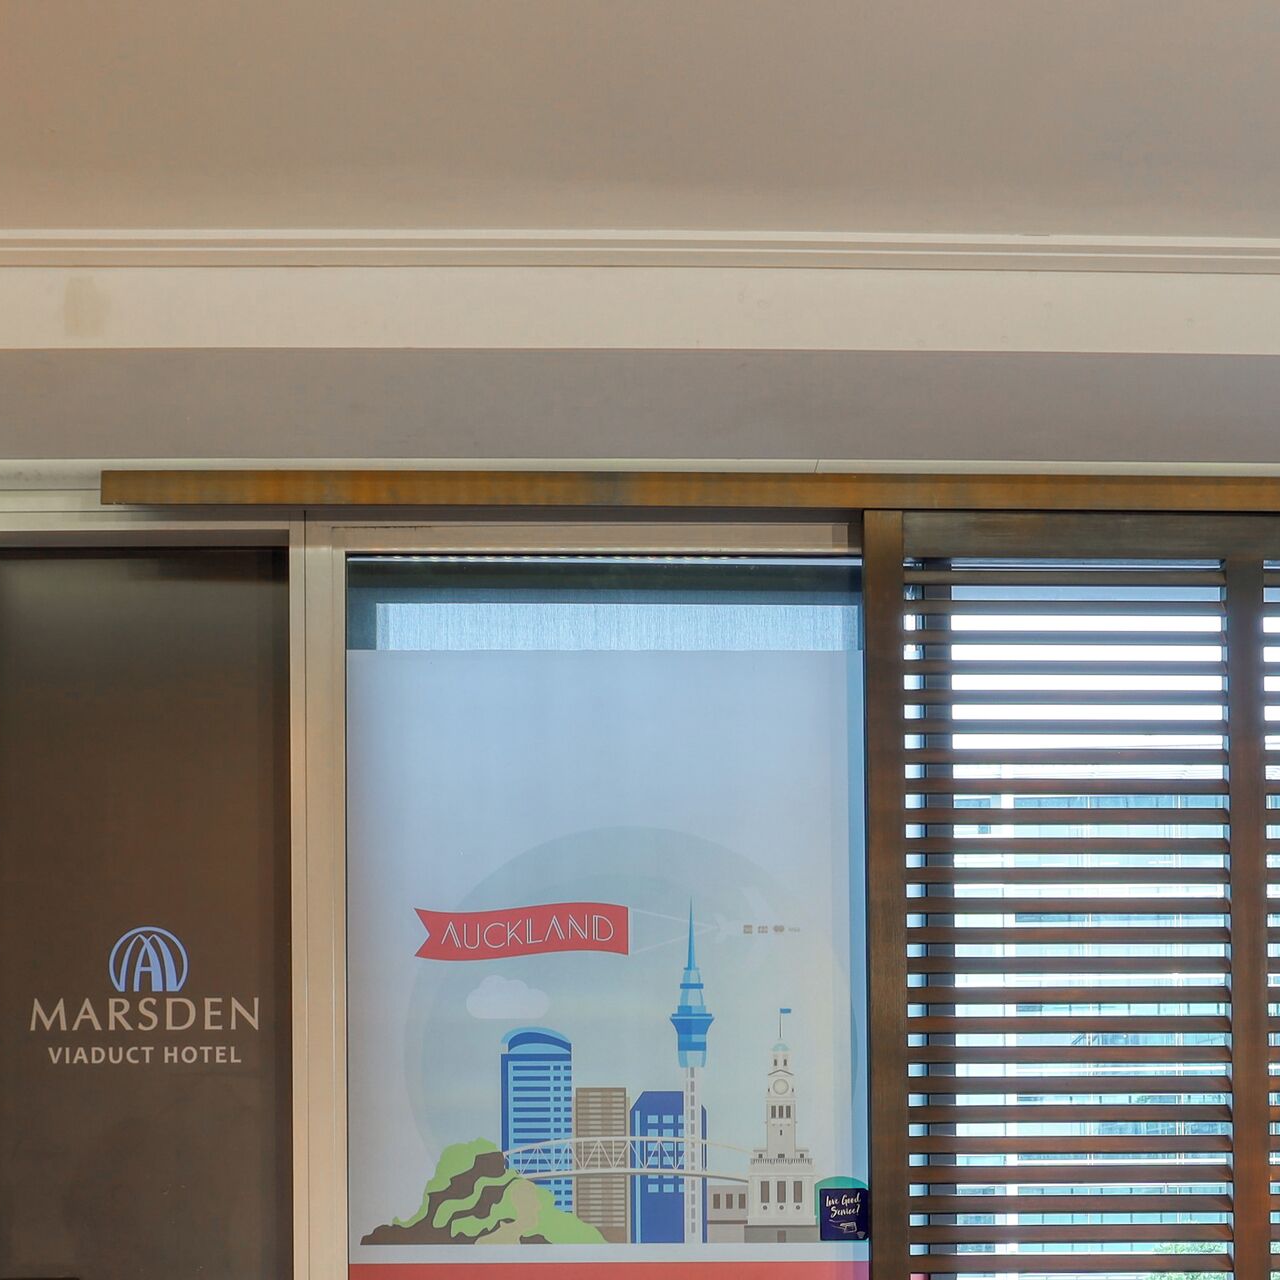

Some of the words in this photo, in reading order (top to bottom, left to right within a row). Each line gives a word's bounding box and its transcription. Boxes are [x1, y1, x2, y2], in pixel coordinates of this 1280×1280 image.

[441, 913, 614, 950] AUCKLAND
[30, 997, 260, 1031] MARSDEN
[48, 1046, 154, 1064] VIADUCT
[164, 1046, 242, 1064] HOTEL
[841, 1192, 862, 1207] Good
